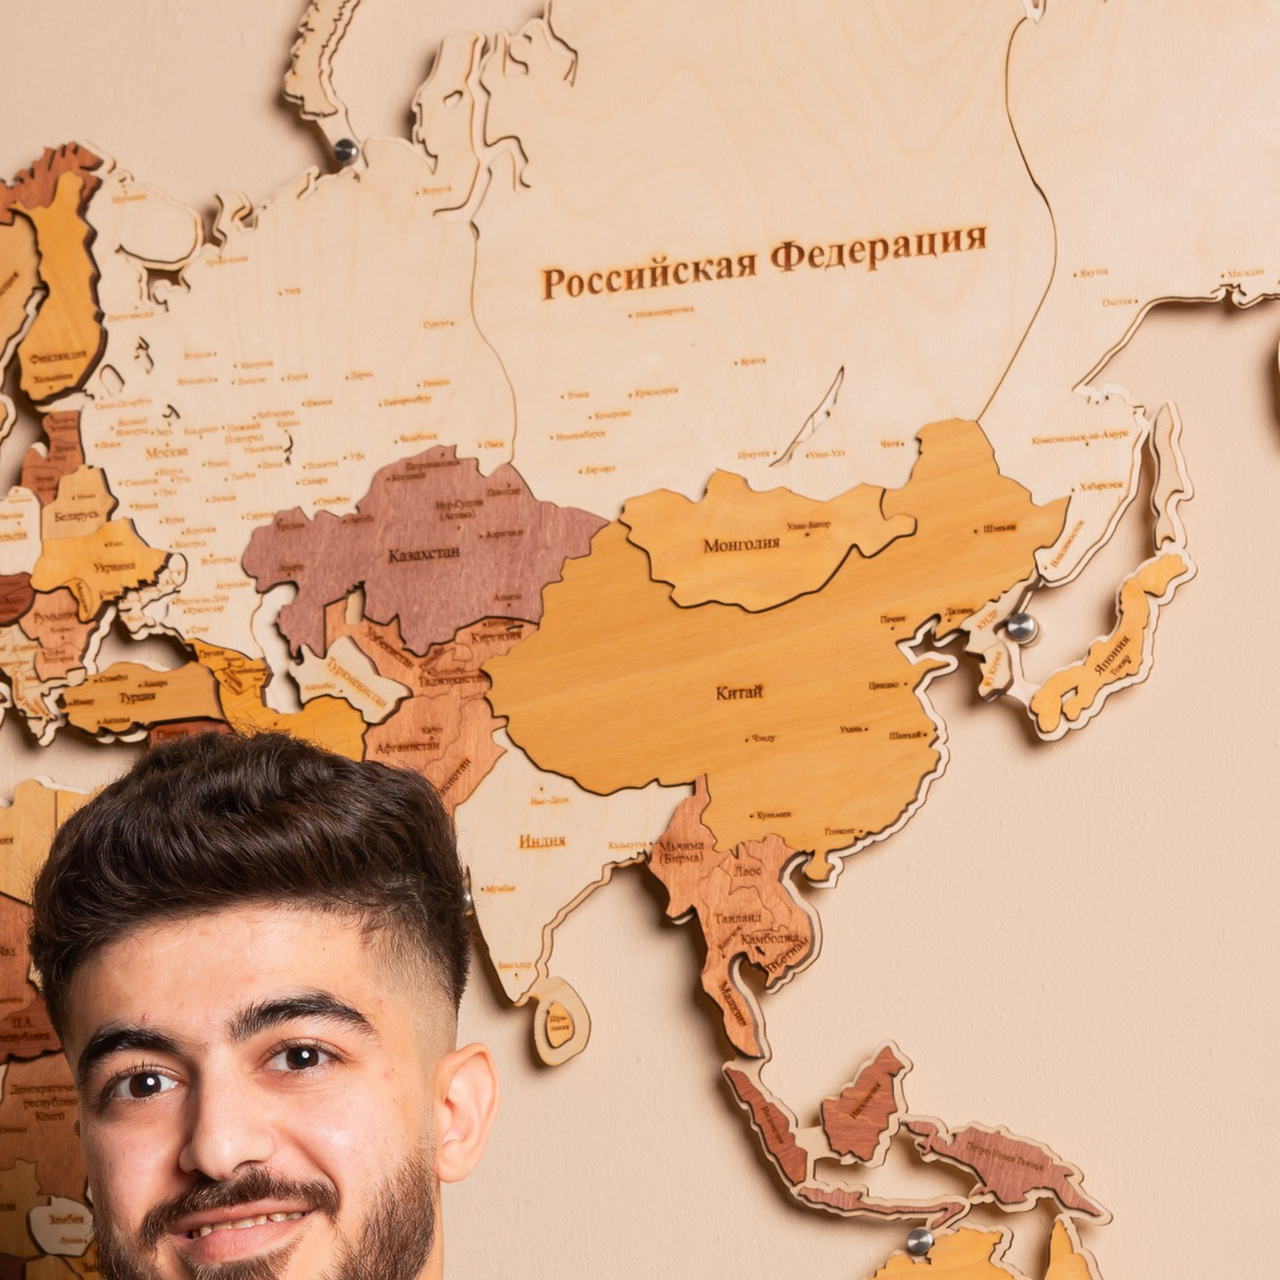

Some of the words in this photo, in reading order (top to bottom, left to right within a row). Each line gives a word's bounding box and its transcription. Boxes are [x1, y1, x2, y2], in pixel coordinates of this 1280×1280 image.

[540, 251, 758, 301] Российская
[770, 224, 988, 274] Федерация
[144, 447, 189, 460] Москва
[54, 510, 100, 524] Беларусь
[703, 534, 781, 555] Монголия
[388, 547, 461, 563] Казахстан
[94, 561, 136, 574] Украина
[1094, 635, 1131, 677] Япония
[326, 657, 387, 709] Туркменистан
[120, 691, 156, 704] Турция
[714, 684, 764, 703] Китай
[519, 833, 567, 850] Индия
[658, 840, 705, 853] Мьянма
[658, 852, 705, 867] (Бирма)
[733, 866, 762, 879] Лаос
[741, 931, 800, 947] Камбоджа
[766, 936, 810, 975] Вьетнам
[35, 1110, 66, 1123] Конго
